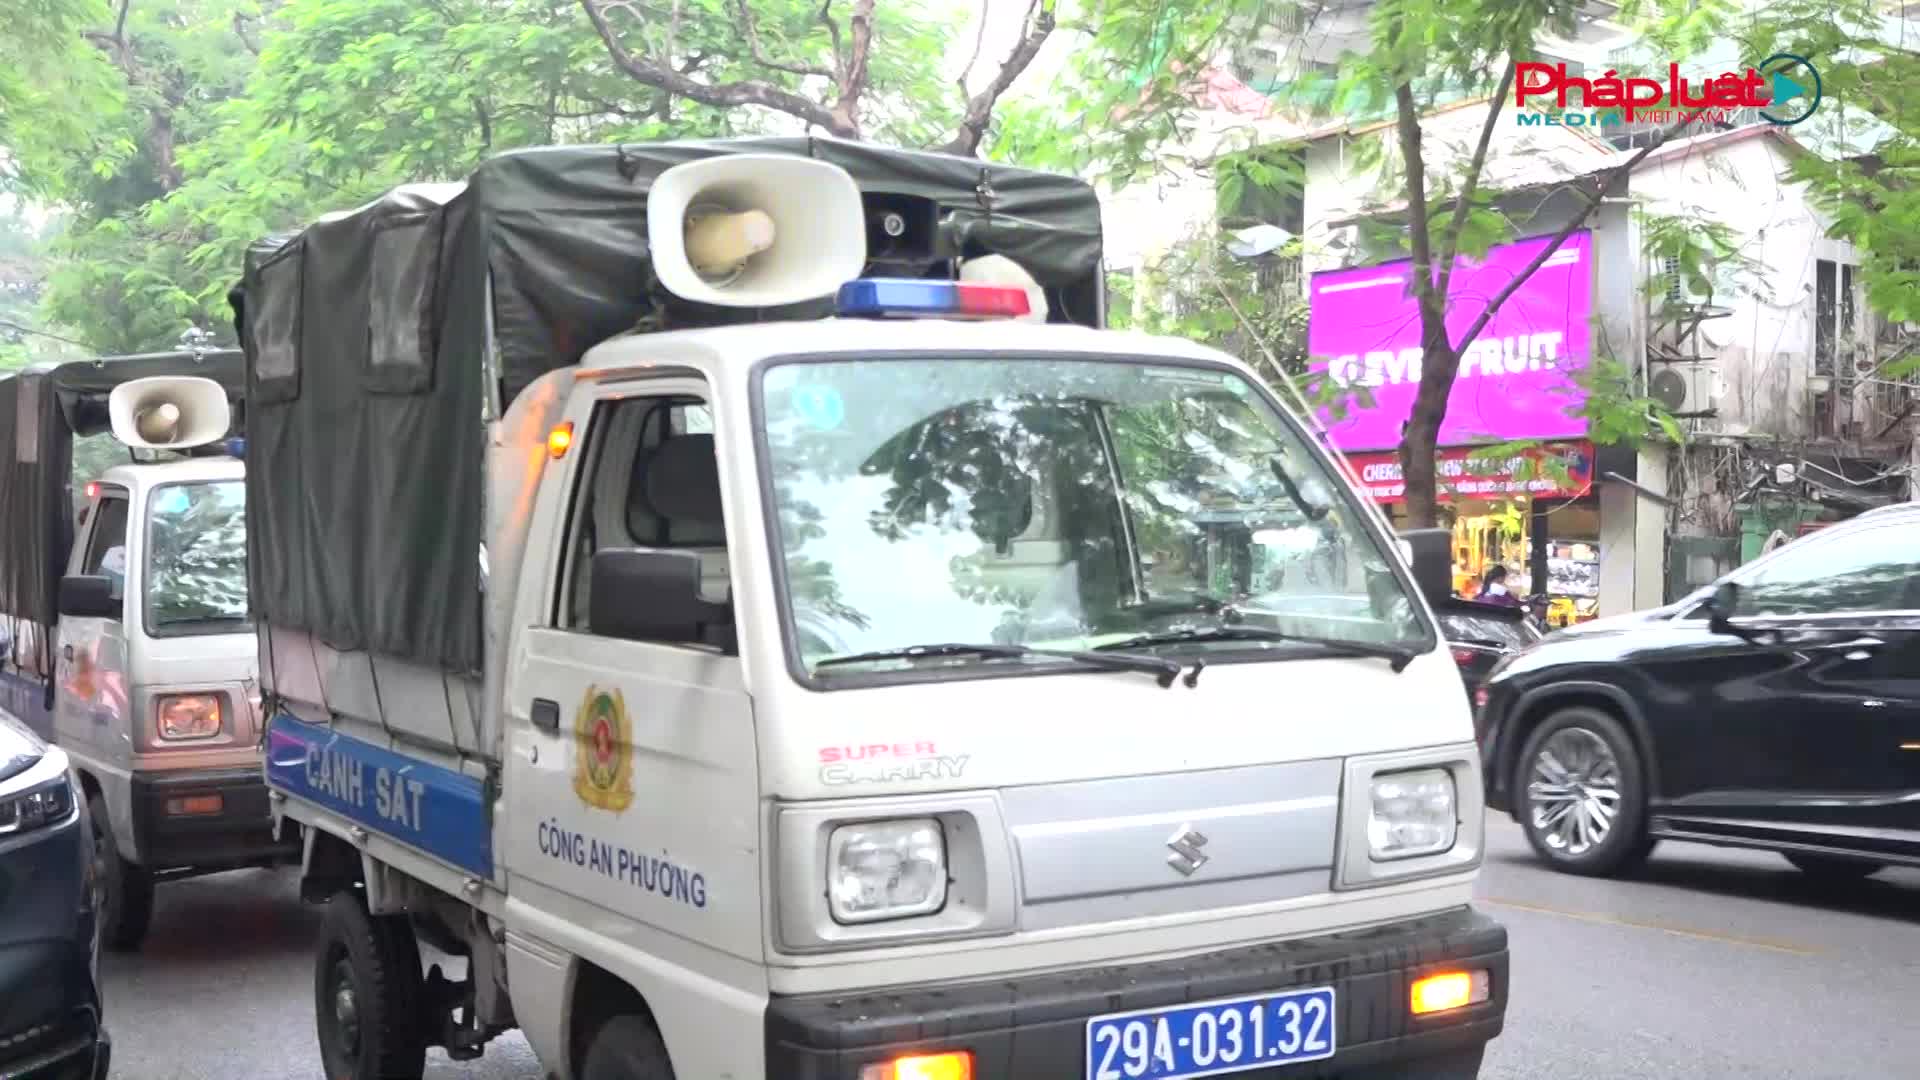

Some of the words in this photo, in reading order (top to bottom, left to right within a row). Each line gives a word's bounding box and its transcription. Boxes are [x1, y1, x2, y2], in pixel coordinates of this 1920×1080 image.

[1458, 332, 1562, 378] FRUIT
[818, 741, 937, 763] SUPER
[818, 754, 971, 786] CARRY
[375, 763, 425, 832] SÁT
[538, 817, 585, 866] CÔNG
[589, 838, 613, 877] AN
[1095, 996, 1328, 1080] 29A-031.32
